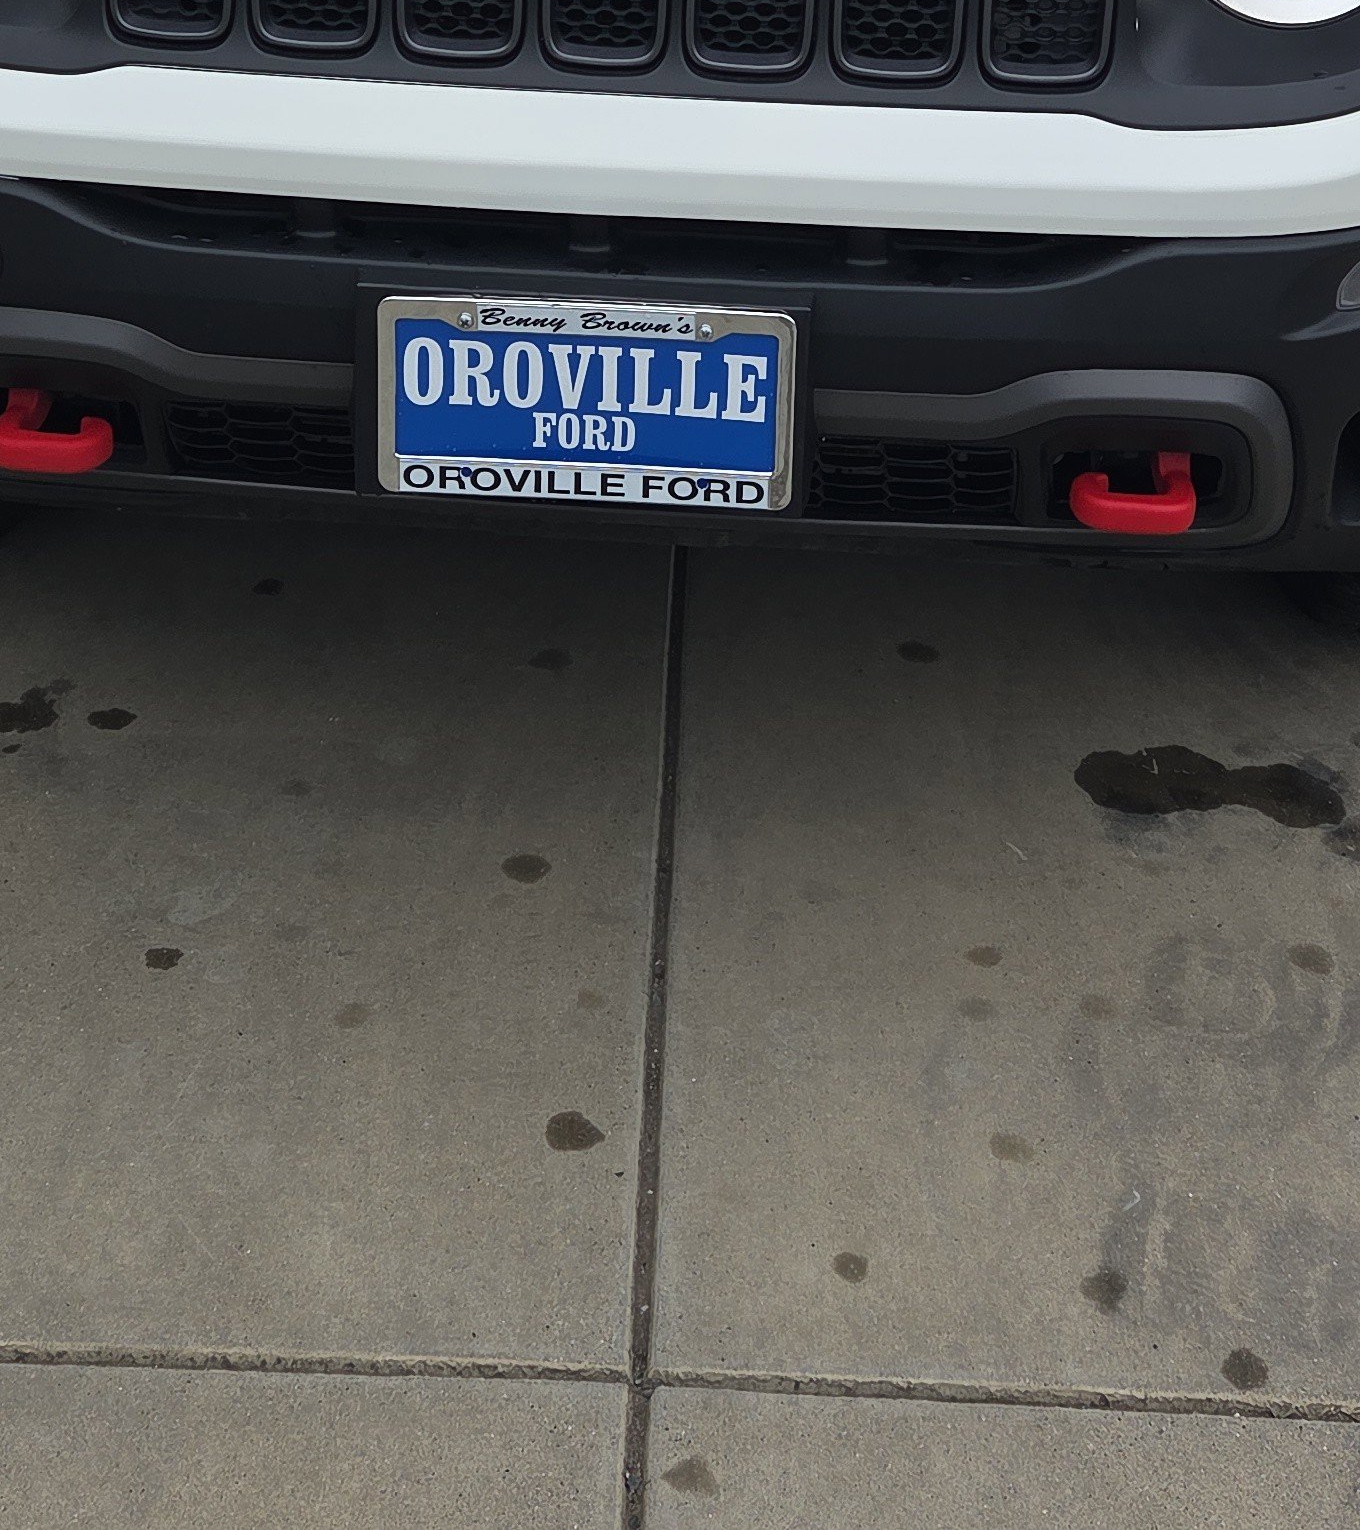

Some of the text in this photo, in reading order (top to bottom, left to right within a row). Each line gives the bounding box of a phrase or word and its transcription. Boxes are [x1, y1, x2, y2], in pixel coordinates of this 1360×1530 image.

[479, 307, 694, 335] Benny Brown's
[403, 336, 769, 423] OROVILLE
[532, 411, 637, 453] FORD
[403, 463, 766, 505] OROVILLE FORD
